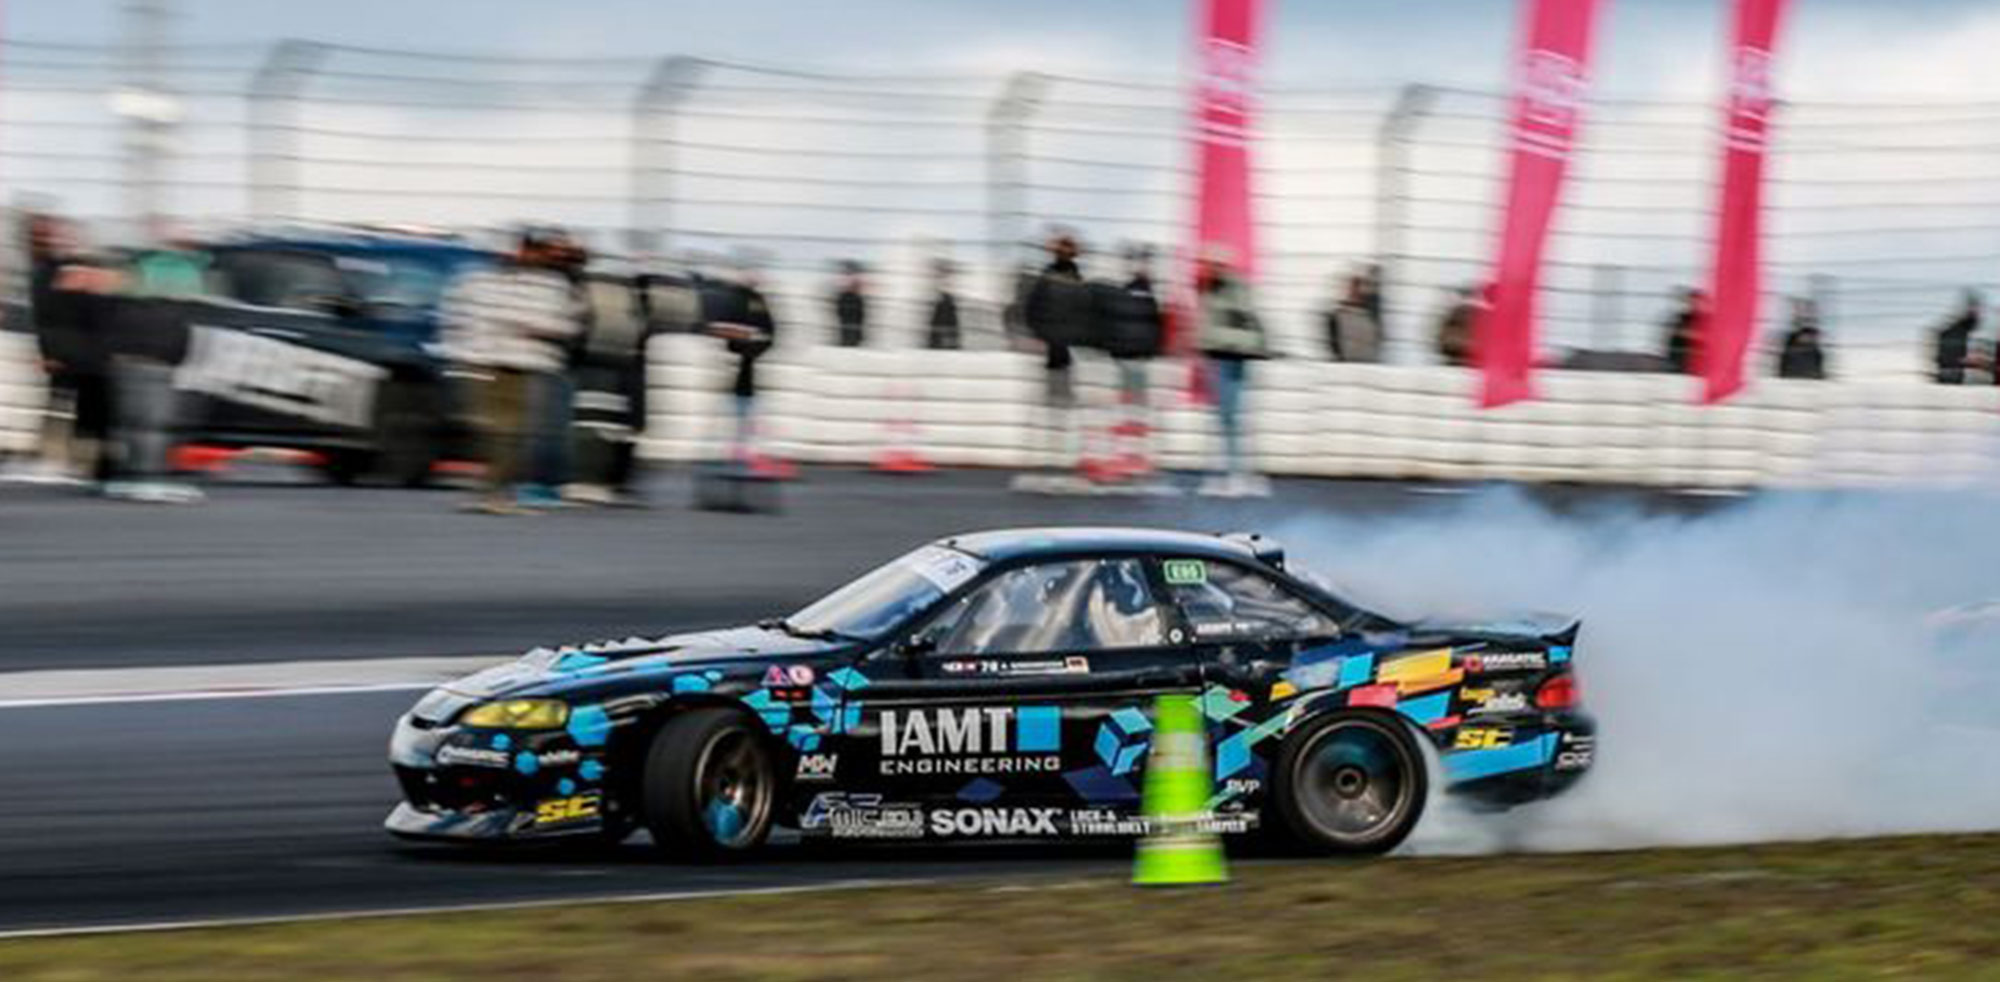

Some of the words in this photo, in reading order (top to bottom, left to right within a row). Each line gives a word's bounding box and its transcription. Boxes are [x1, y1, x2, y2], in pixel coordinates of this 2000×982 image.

[880, 707, 1014, 756] IAMT
[879, 756, 1062, 775] ENGINEERING
[931, 808, 1059, 835] SONAX
